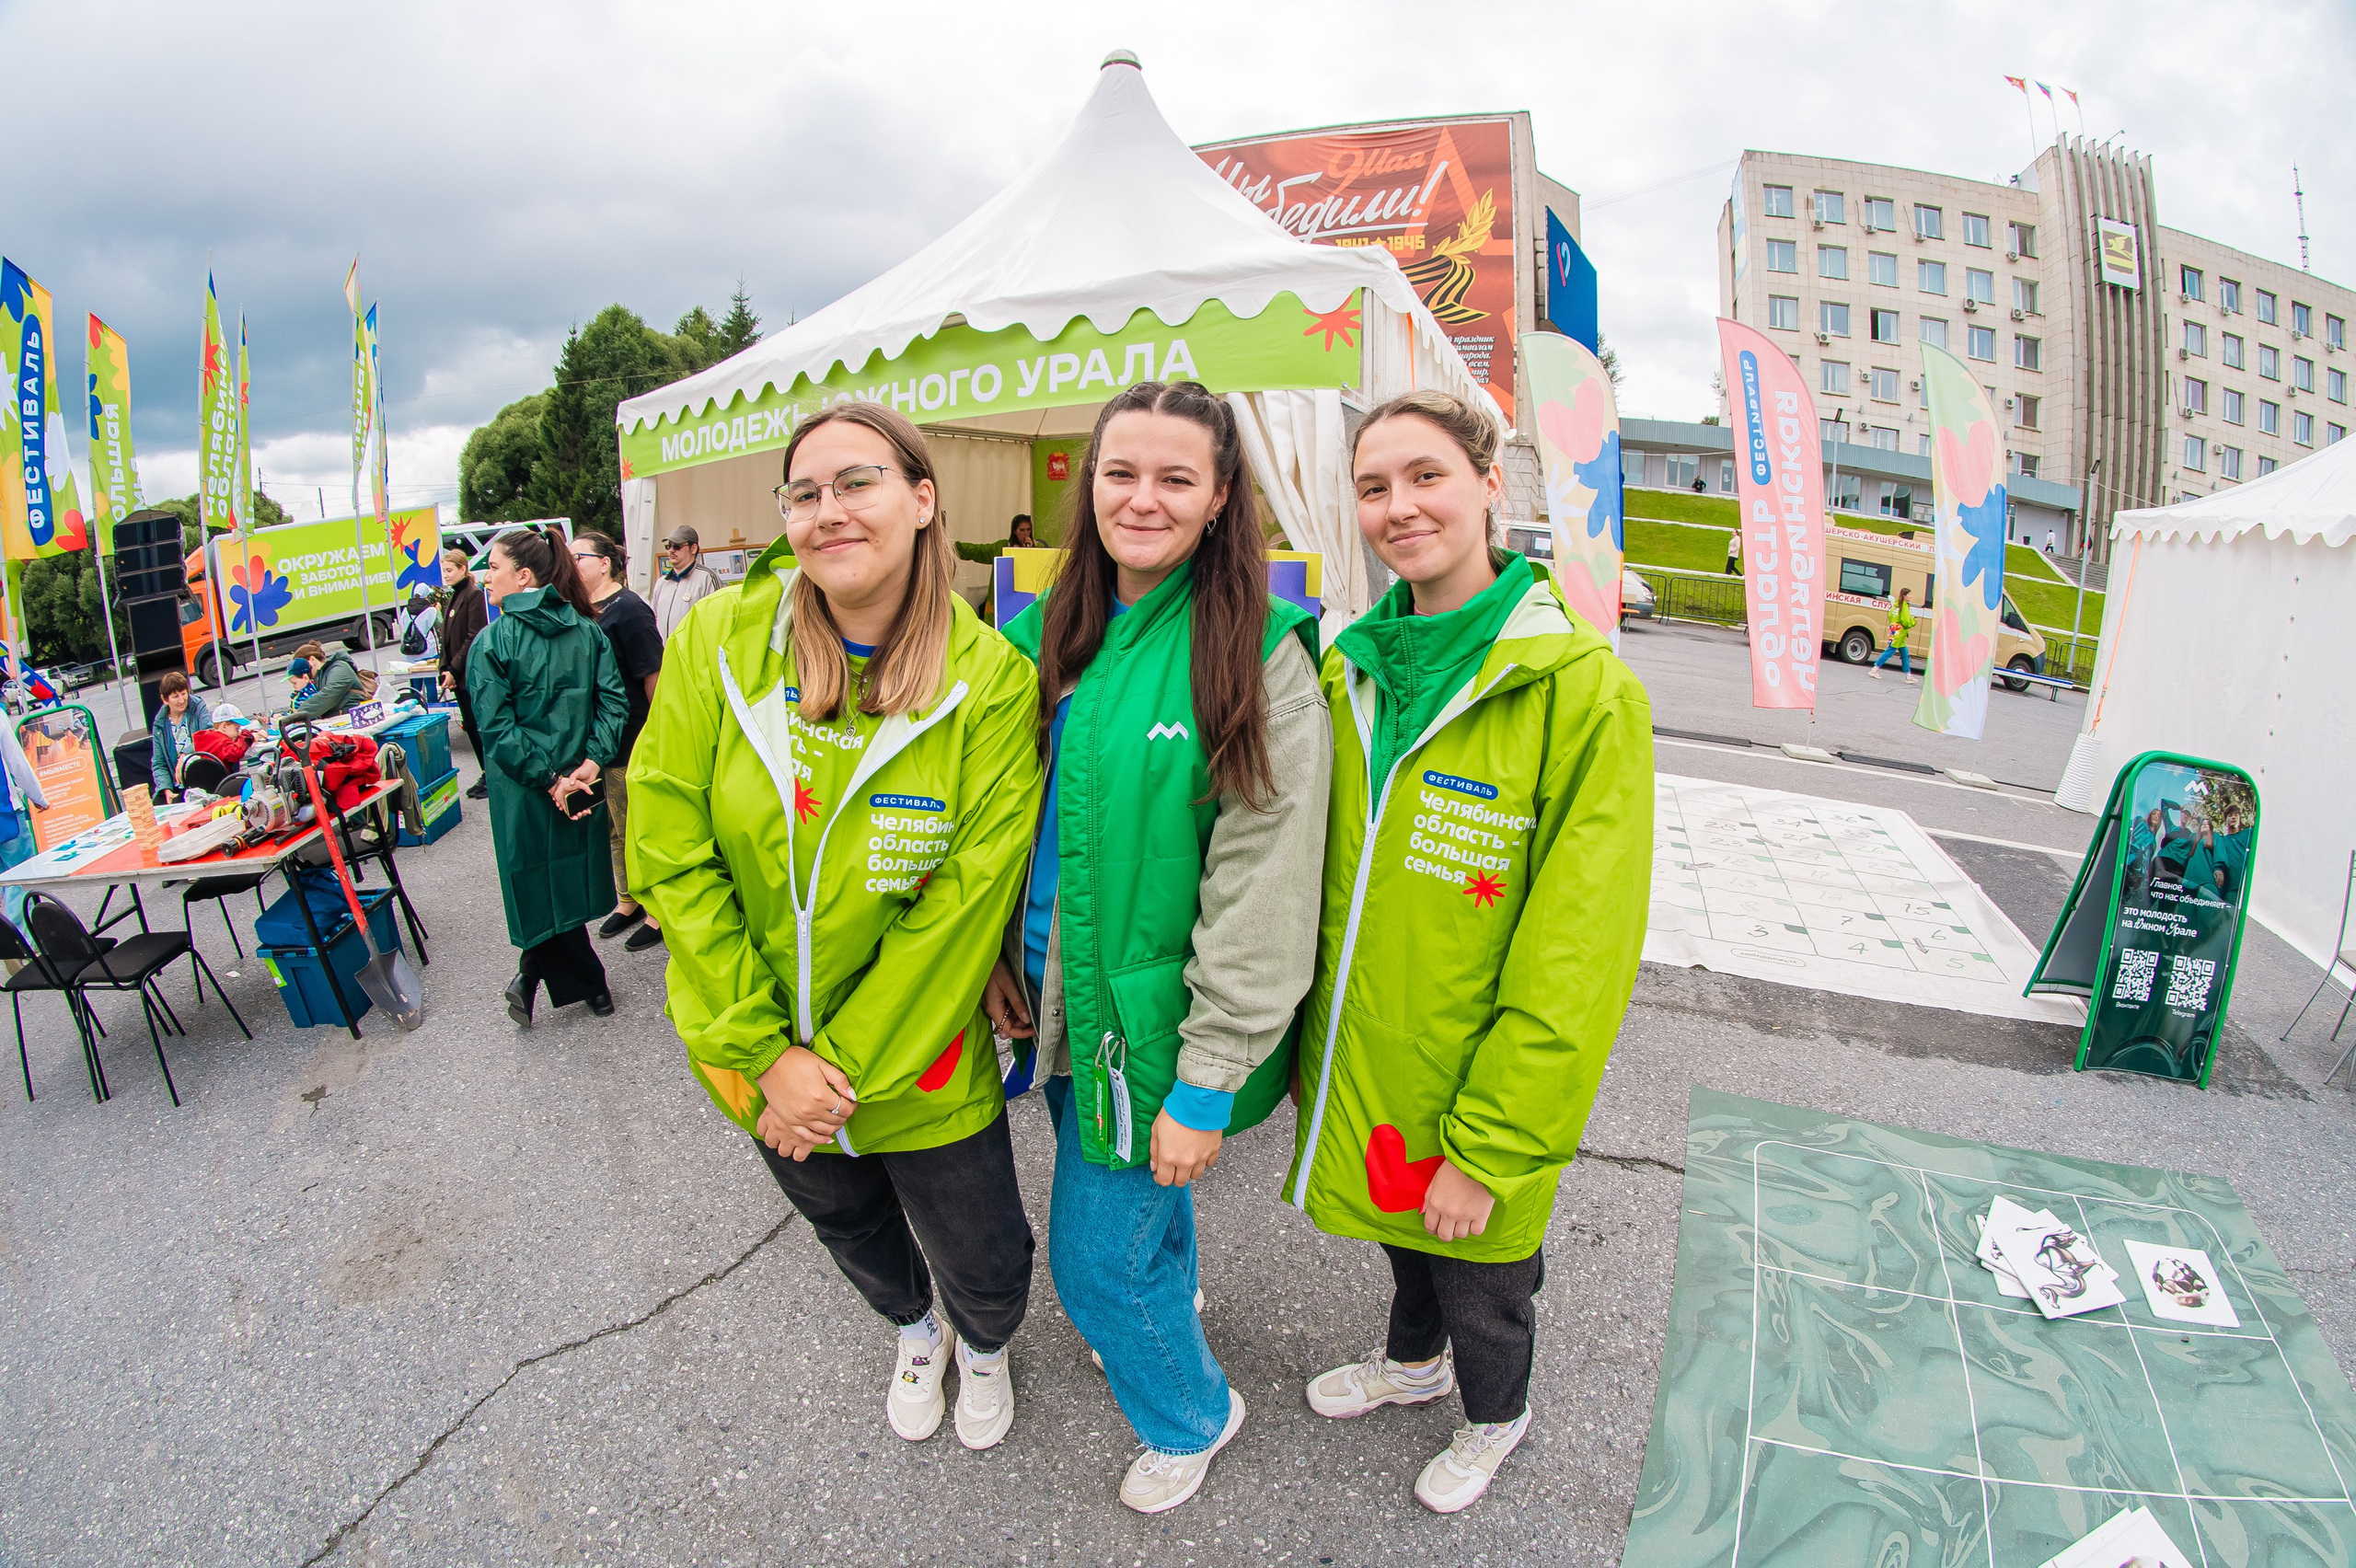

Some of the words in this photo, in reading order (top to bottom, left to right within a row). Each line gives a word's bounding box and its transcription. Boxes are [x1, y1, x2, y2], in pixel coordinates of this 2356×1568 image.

[1388, 236, 1426, 250] 1945
[662, 403, 810, 462] МОЛОДЕЖЬ
[1017, 339, 1200, 397] УРАЛА
[23, 331, 43, 529] ФЕСТИВАЛЬ
[103, 403, 127, 522] ольшая
[278, 542, 386, 573] ОКРУЖАЕМ
[294, 588, 305, 600] И
[1428, 774, 1493, 796] ФЕСТИВАЛЬ
[871, 813, 954, 834] Челябин
[1414, 814, 1505, 849] область
[1773, 818, 1803, 827] 34
[869, 834, 949, 853] область
[1410, 831, 1511, 870] большая
[1783, 833, 1809, 842] 27
[1855, 845, 1884, 854] 26
[1789, 850, 1822, 860] 24
[1404, 855, 1466, 885] семья
[2150, 877, 2184, 893] Главное,
[1904, 903, 1930, 916] 15
[2151, 891, 2164, 899] что
[2165, 894, 2178, 902] нас
[2179, 894, 2225, 909] объединяет
[2123, 906, 2139, 916] это
[2140, 908, 2189, 923] молодость
[1841, 916, 1854, 926] 7
[1931, 929, 1946, 940] 6
[2121, 919, 2133, 928] на
[2133, 917, 2166, 932] Южном
[2165, 922, 2198, 937] Урале
[1748, 925, 1769, 938] 3
[1848, 942, 1869, 954] 4
[1946, 957, 1965, 968] 5
[2172, 1009, 2196, 1018] Telegram
